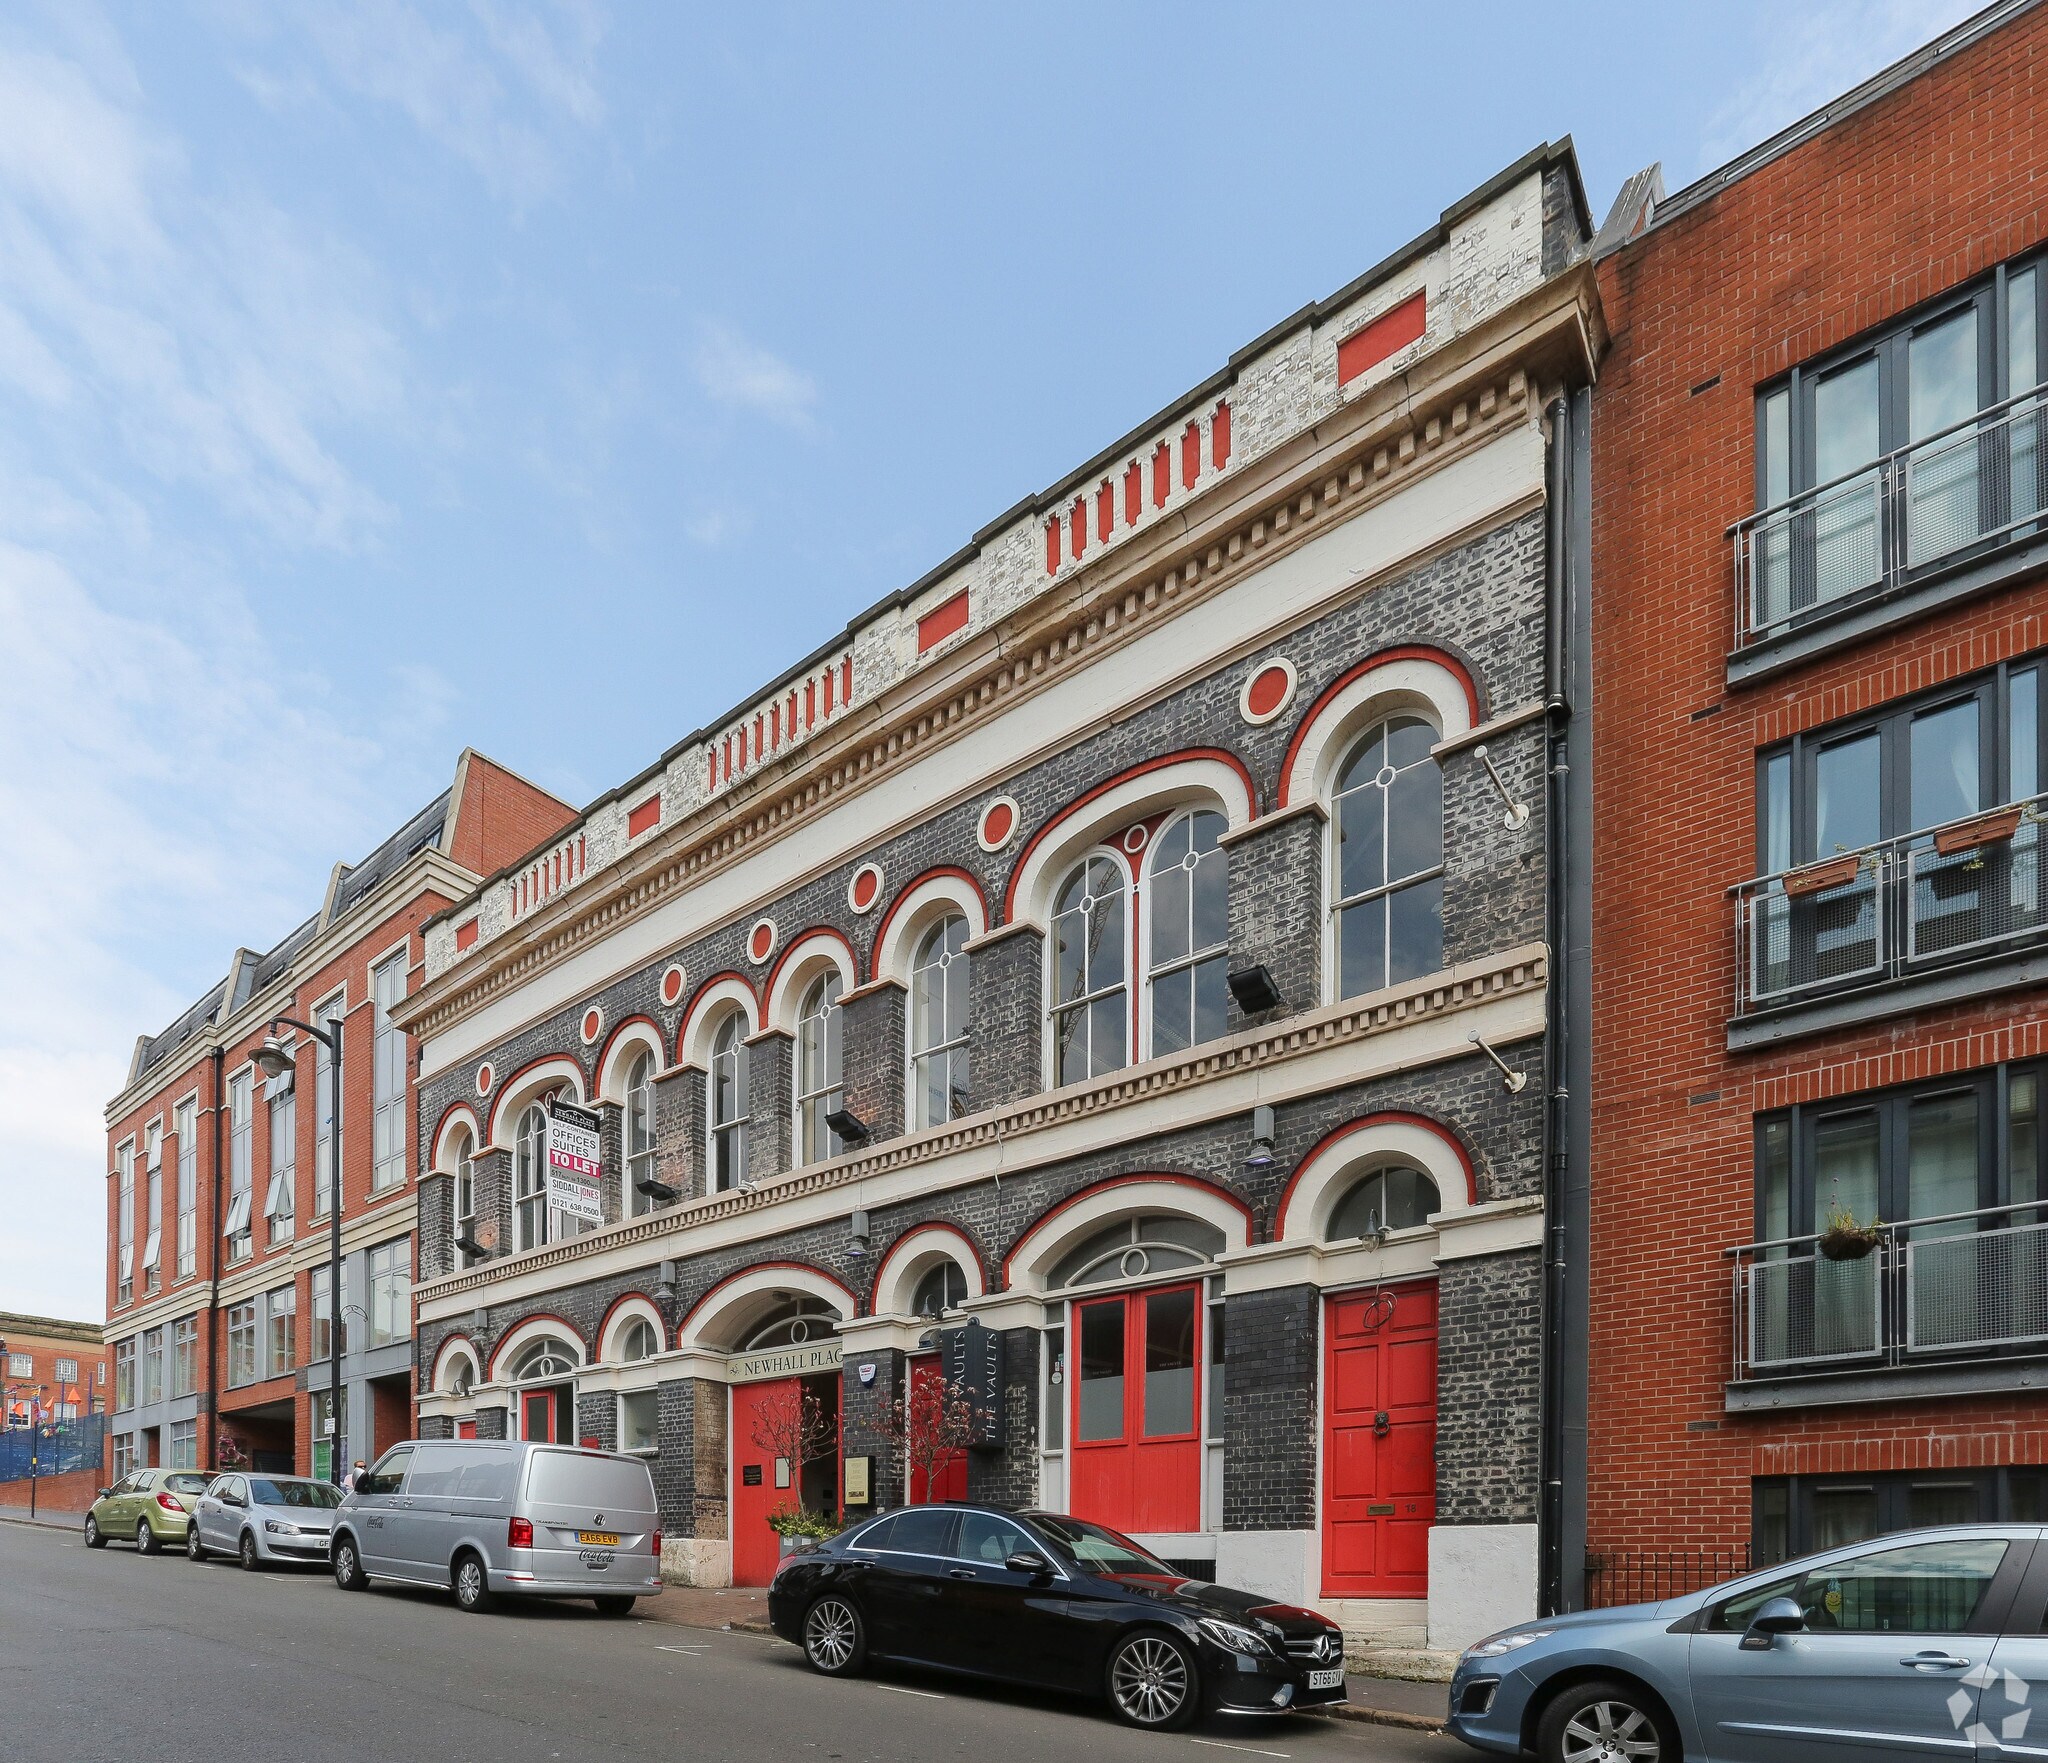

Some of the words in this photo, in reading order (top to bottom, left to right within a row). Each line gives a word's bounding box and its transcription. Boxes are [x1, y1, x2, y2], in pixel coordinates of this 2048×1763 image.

[552, 1128, 596, 1150] OFFICES
[552, 1139, 589, 1158] SUITES
[551, 1151, 570, 1167] TO
[573, 1157, 599, 1176] LET
[551, 1169, 562, 1178] 517
[552, 1179, 580, 1195] SIDDALL
[579, 1186, 599, 1202] JONES
[551, 1197, 568, 1208] 0121
[569, 1202, 582, 1212] 638
[583, 1206, 599, 1217] 0500
[744, 1354, 806, 1375] NEWHALL
[986, 1332, 997, 1399] VAULTS
[986, 1405, 997, 1441] THE
[580, 1533, 601, 1543] EA66
